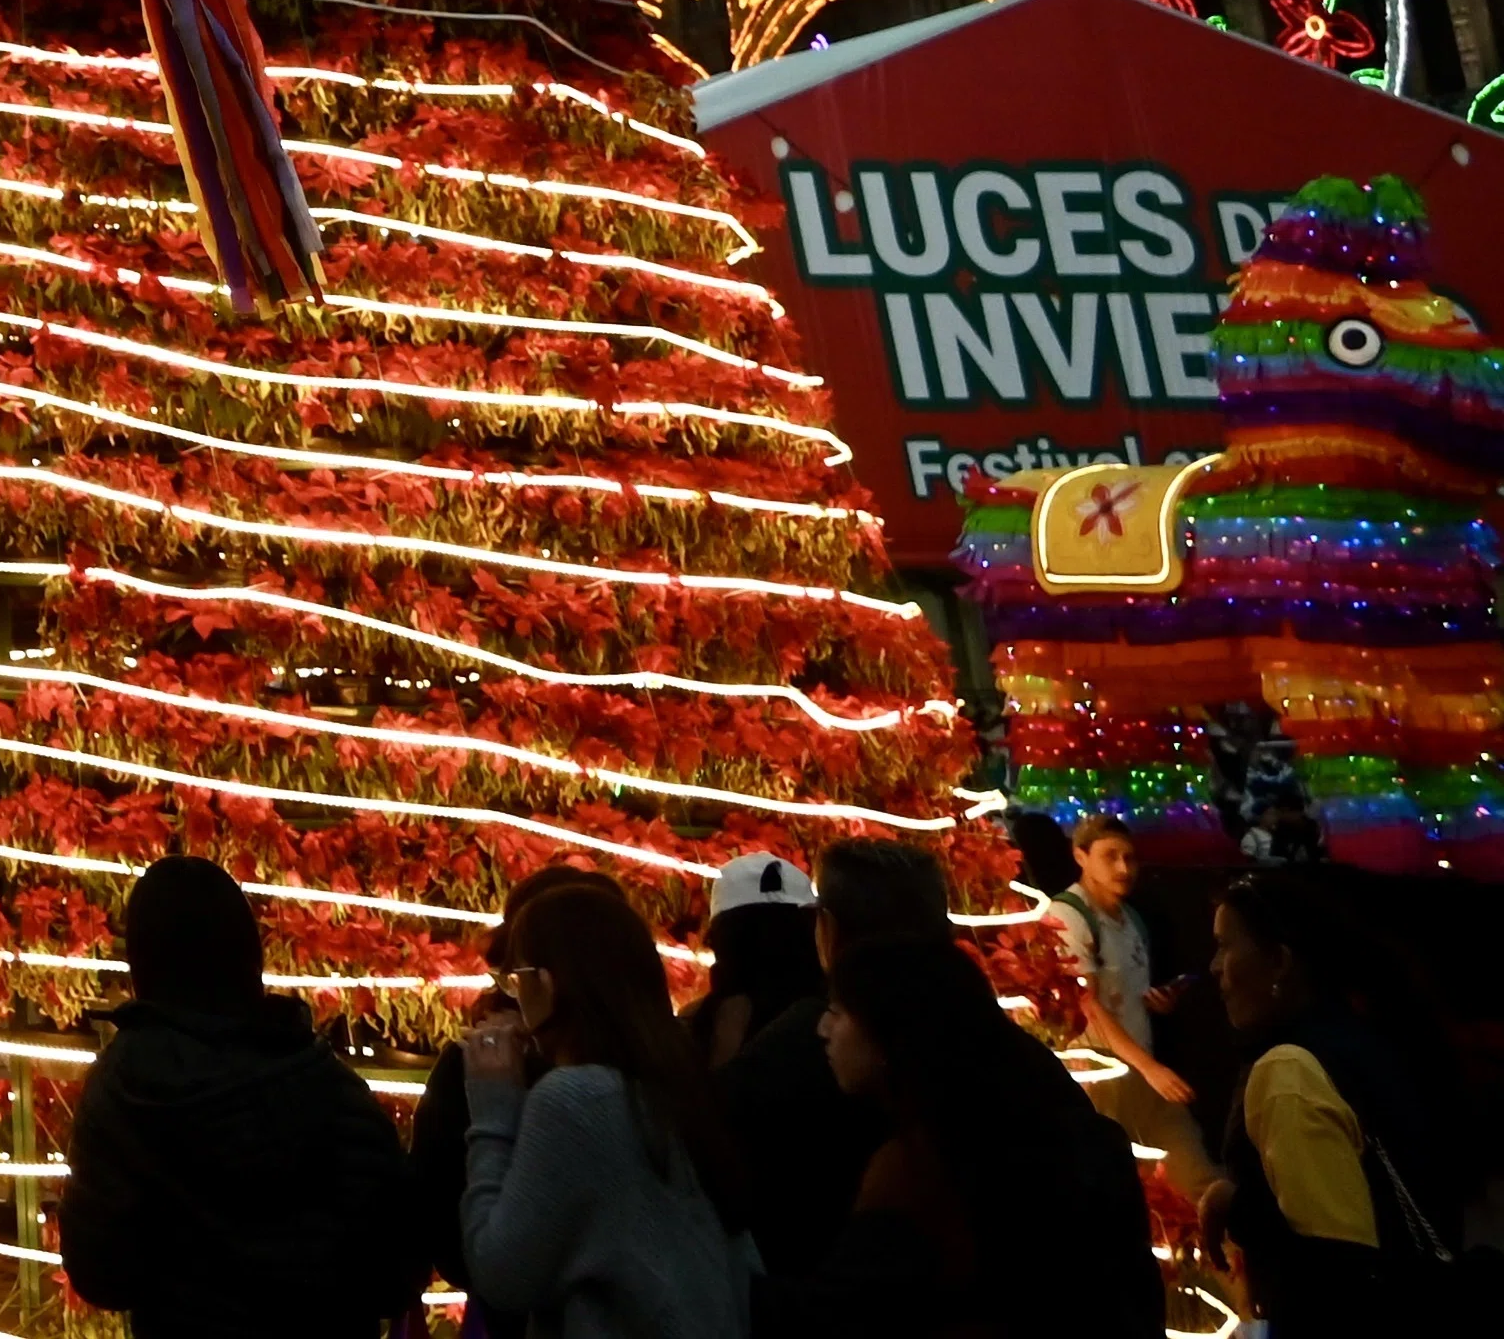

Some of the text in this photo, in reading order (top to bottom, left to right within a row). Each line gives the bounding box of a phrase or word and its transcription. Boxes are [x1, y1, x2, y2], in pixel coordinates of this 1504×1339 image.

[788, 170, 1287, 277] LUCES D
[884, 292, 1232, 401] INVIE
